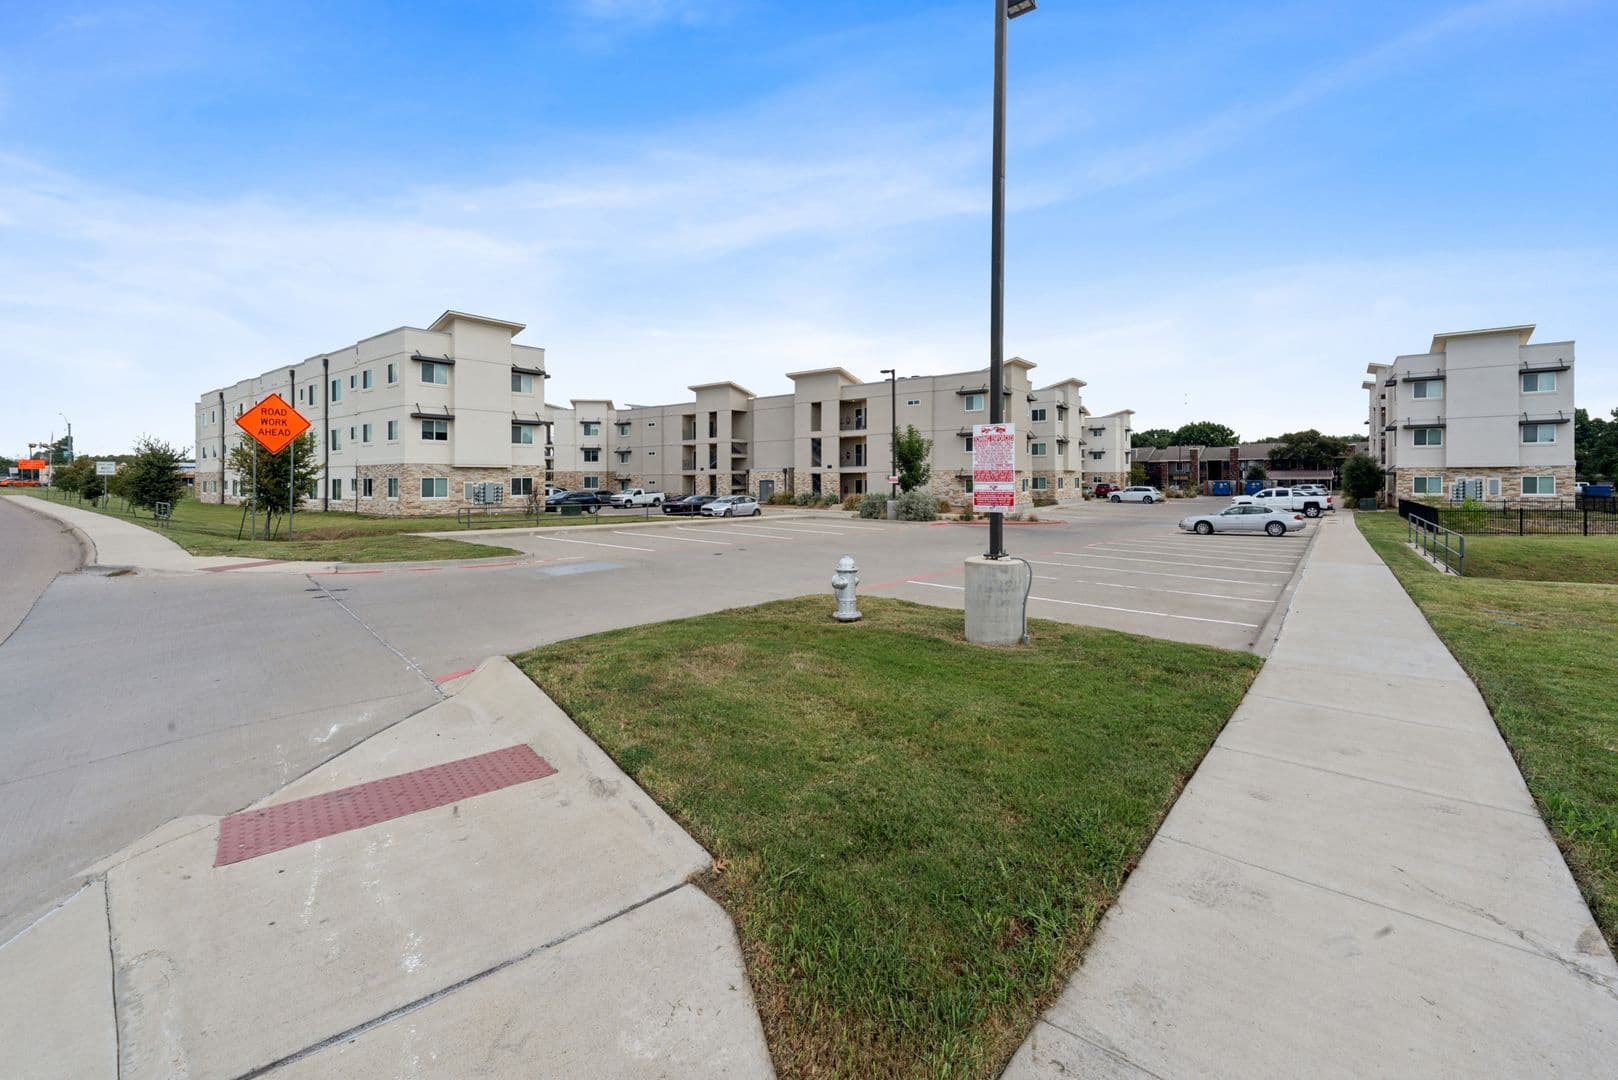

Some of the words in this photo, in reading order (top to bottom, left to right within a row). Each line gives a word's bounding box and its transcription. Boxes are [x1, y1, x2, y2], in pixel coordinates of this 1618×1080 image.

[261, 408, 288, 416] ROAD
[261, 418, 288, 426] WORK
[258, 428, 291, 437] AHEAD
